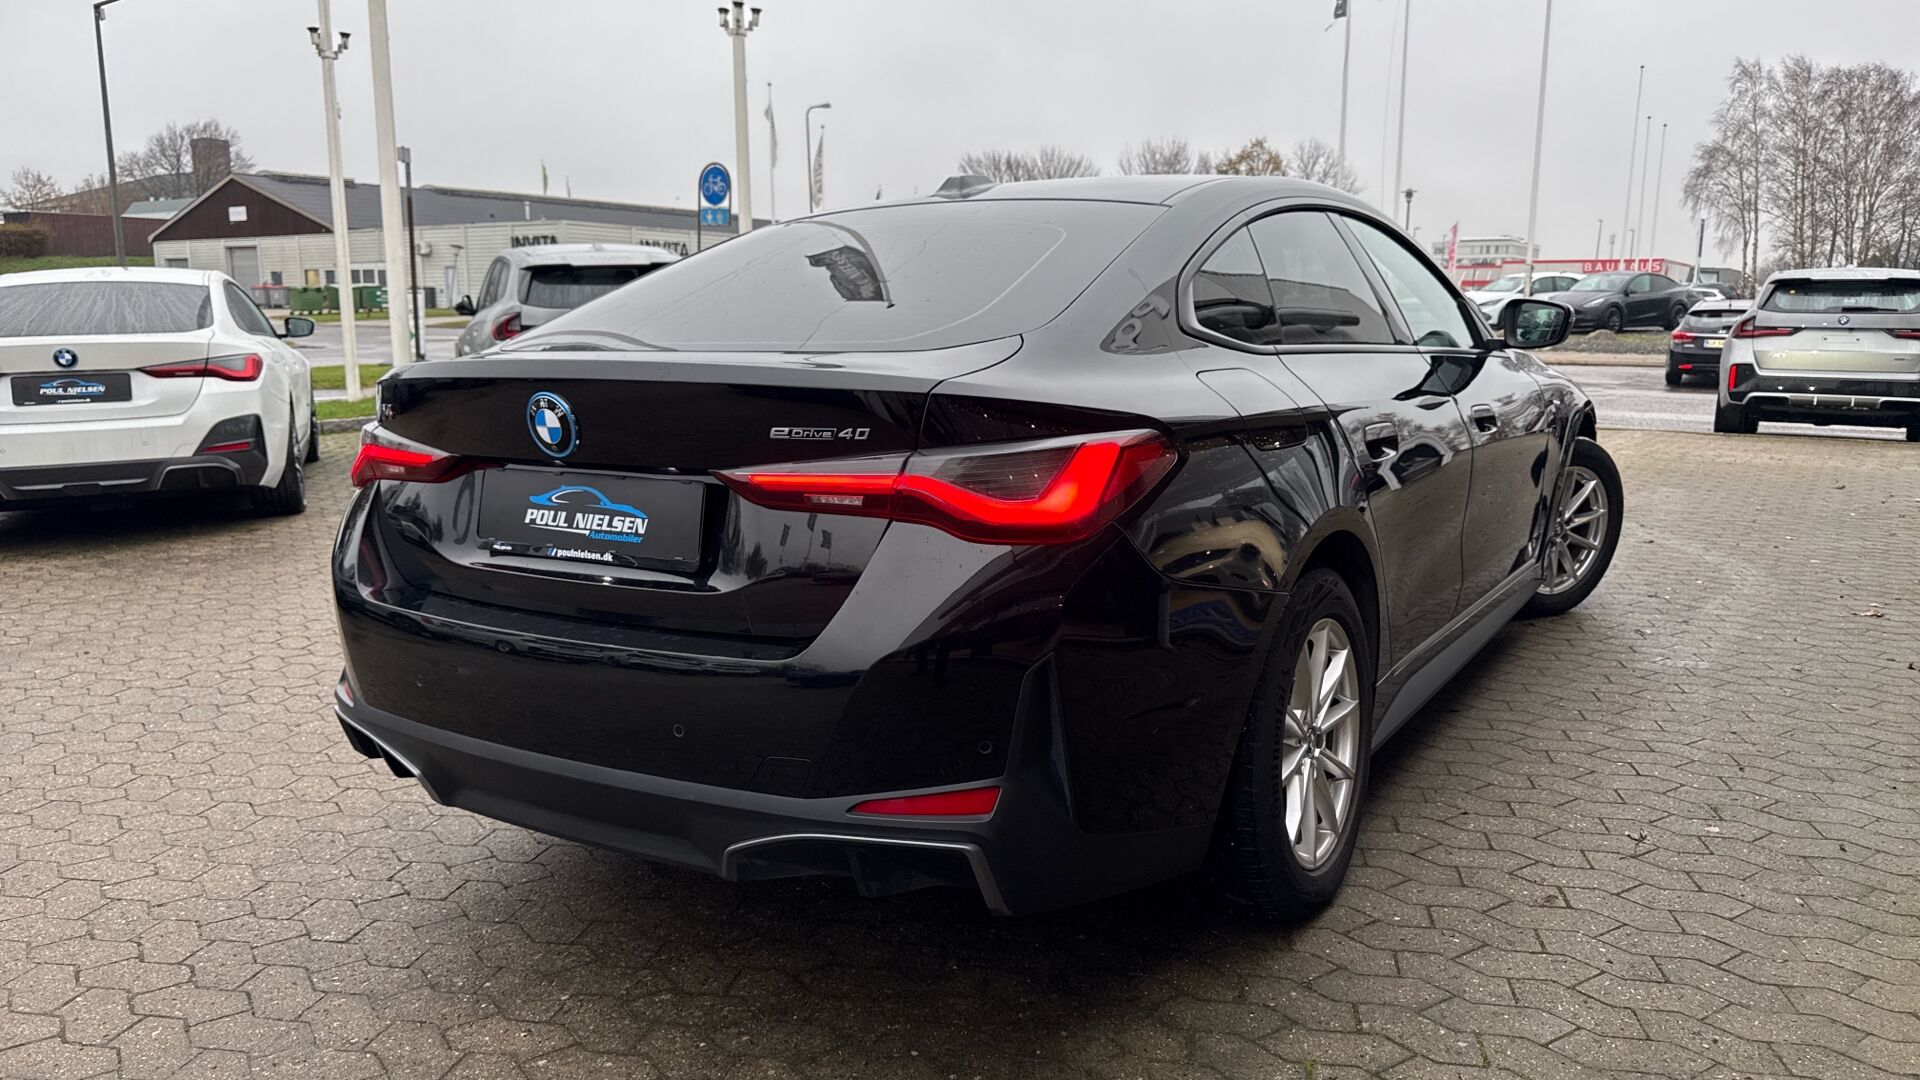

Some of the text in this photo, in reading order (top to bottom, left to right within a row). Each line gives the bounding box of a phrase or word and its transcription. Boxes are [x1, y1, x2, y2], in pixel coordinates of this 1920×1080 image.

[511, 235, 559, 249] INVITA
[769, 427, 870, 440] eDrive 40
[524, 508, 649, 534] POUL NIELSEN
[588, 531, 643, 543] Automobiler
[557, 548, 613, 562] poulnielsen.dk
